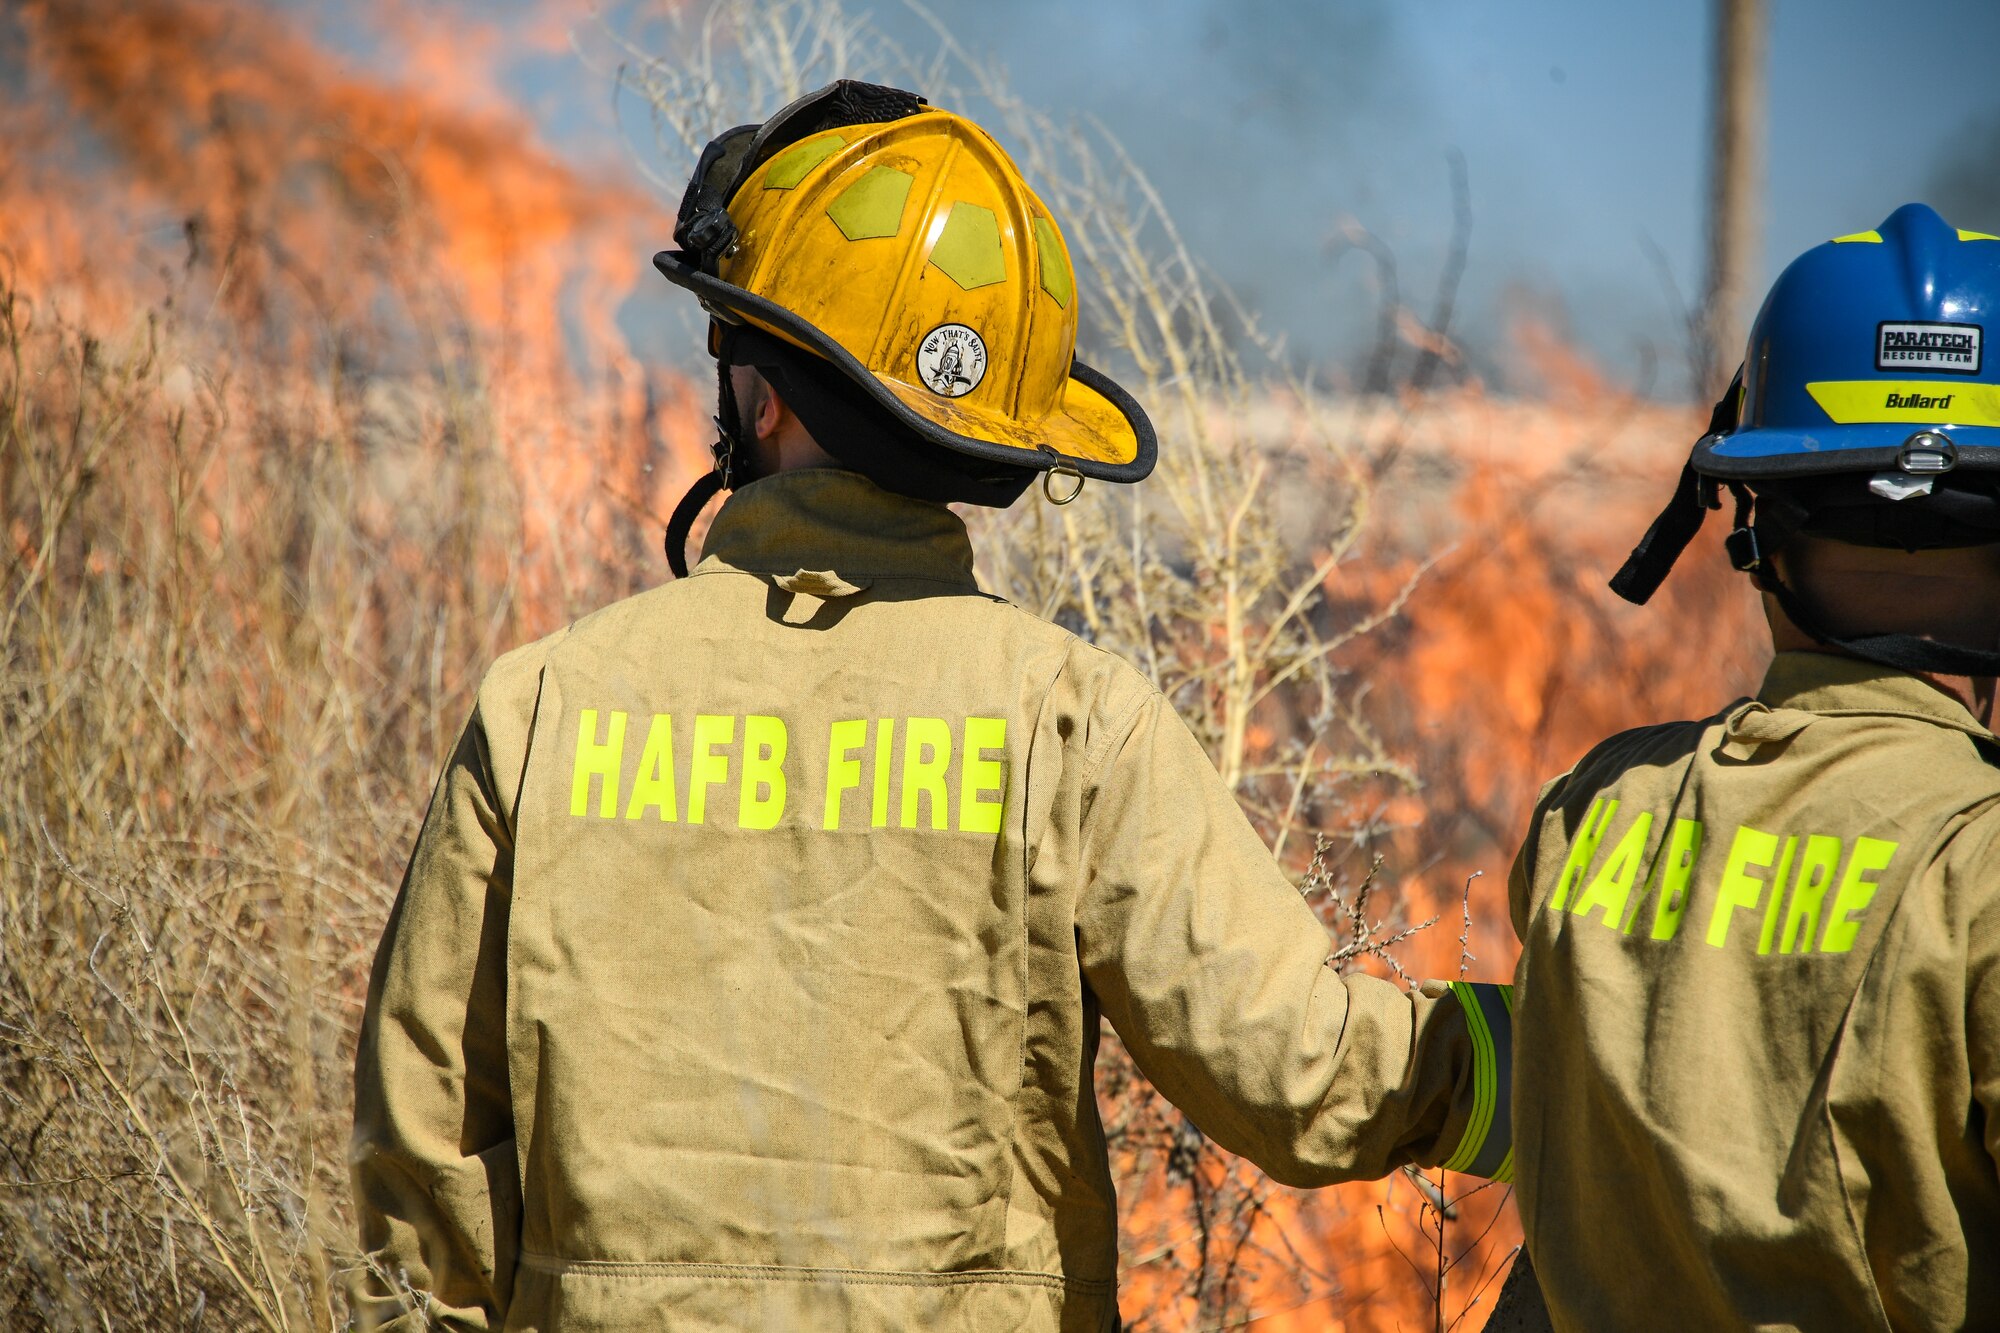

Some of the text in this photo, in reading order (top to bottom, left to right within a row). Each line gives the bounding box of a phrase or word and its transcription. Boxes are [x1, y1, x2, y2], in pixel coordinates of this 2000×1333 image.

[924, 335, 940, 355] NOW
[940, 329, 970, 341] THAT'S
[1884, 331, 1974, 349] PARATECH
[1883, 351, 1973, 363] RESCUE TEAM
[1885, 393, 1953, 409] Bullard
[570, 709, 1007, 834] HAFB FIRE
[1550, 798, 1900, 955] HAB FIRE
